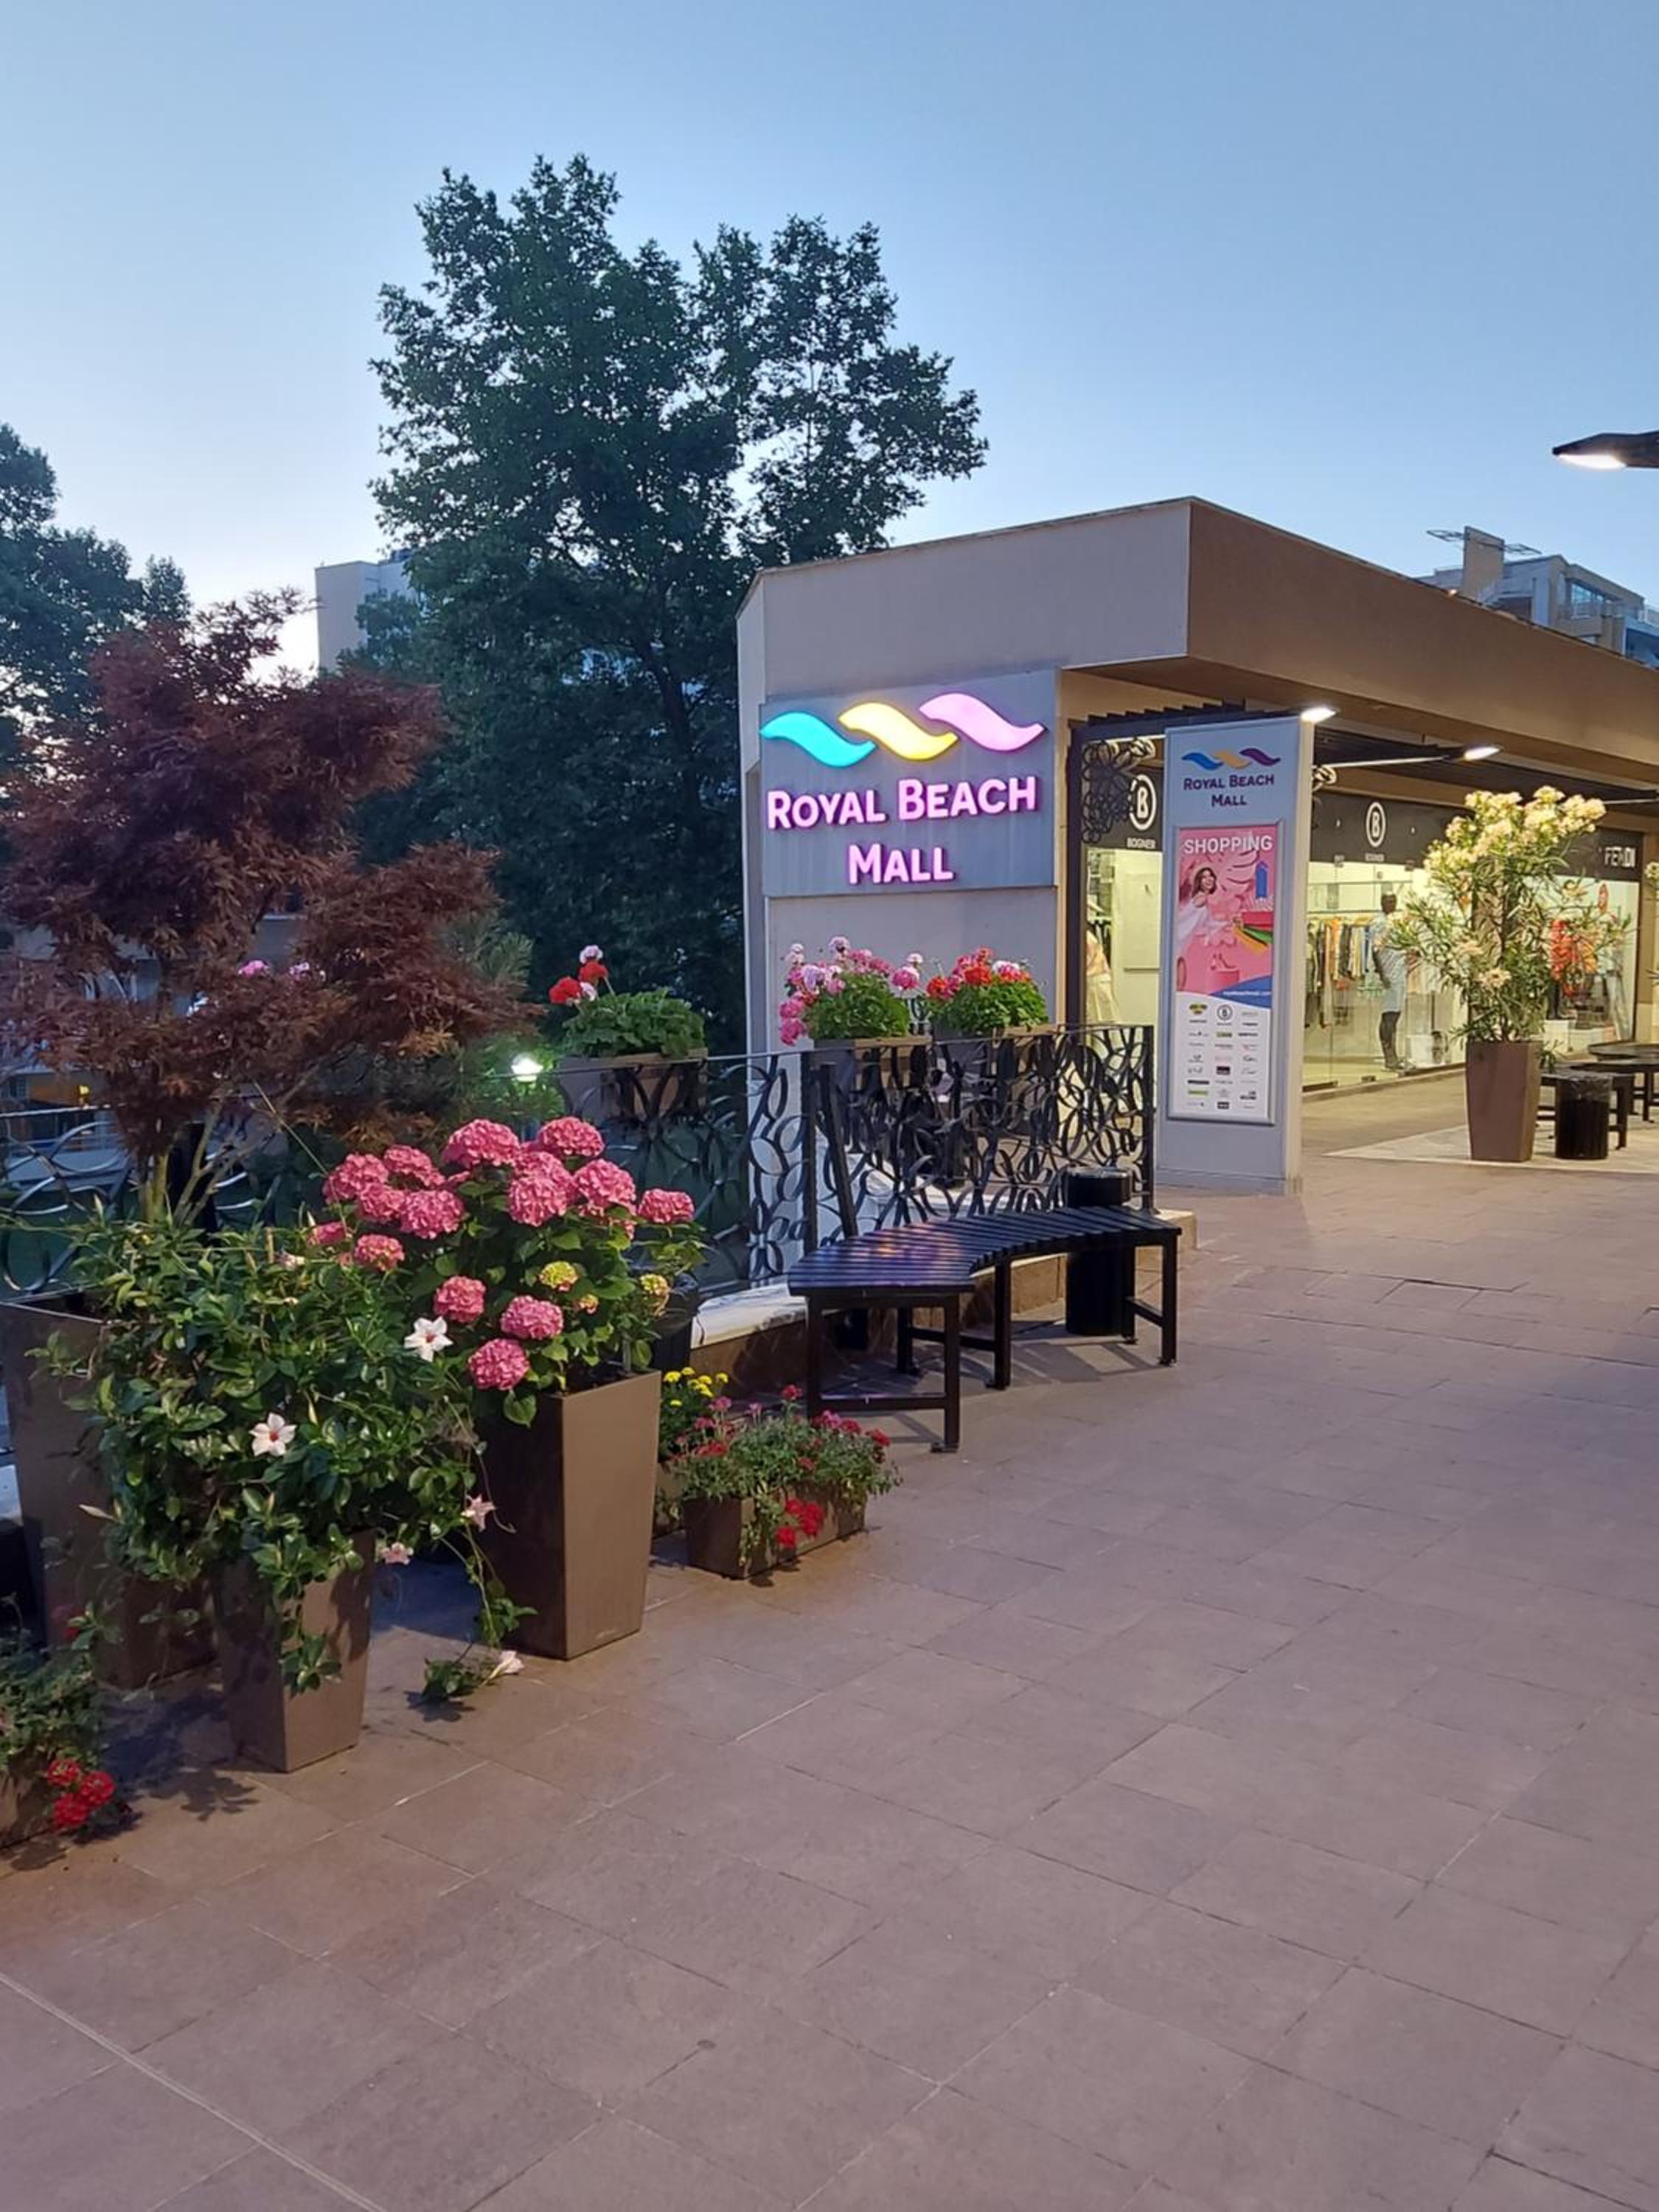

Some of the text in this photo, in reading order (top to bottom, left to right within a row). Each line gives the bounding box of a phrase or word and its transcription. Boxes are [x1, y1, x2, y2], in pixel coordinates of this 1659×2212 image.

[1183, 774, 1275, 790] ROYAL BEACH
[767, 775, 1037, 830] ROYAL BEACH
[1211, 794, 1248, 807] MALL
[1183, 835, 1273, 855] SHOPPING
[848, 843, 956, 886] MALL
